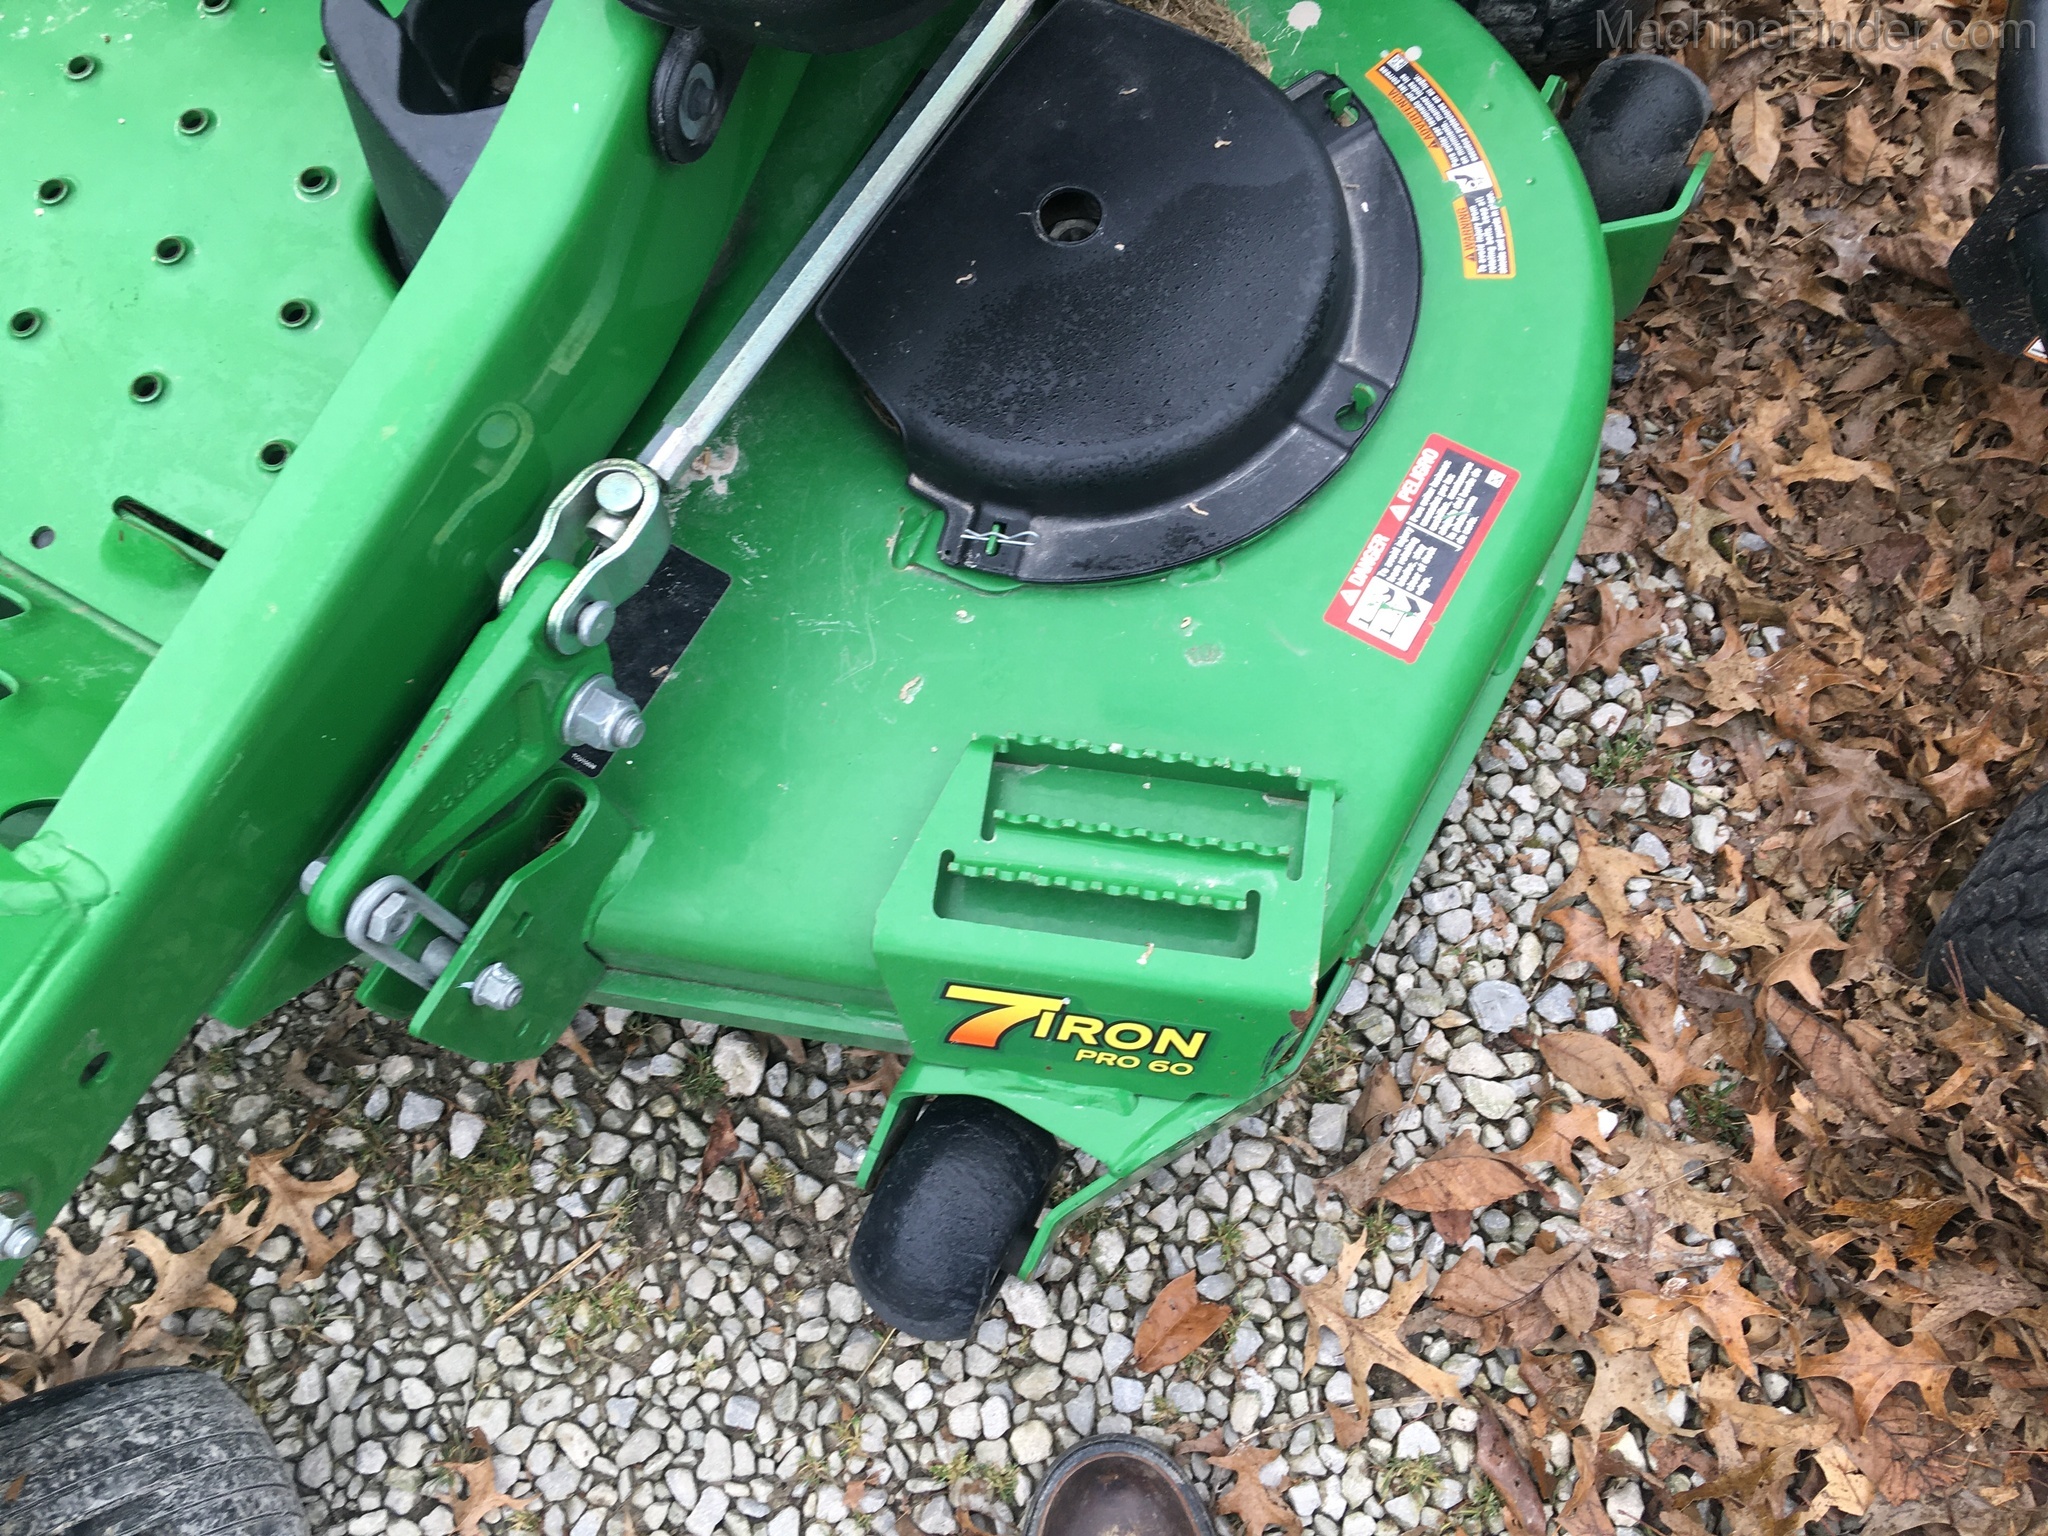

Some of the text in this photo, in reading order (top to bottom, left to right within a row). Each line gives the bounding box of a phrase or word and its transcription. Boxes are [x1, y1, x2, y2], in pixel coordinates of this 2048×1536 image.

[1457, 207, 1474, 250] WARNING
[1348, 533, 1390, 587] DANGER
[1397, 447, 1439, 503] PELIGRO
[1075, 1049, 1194, 1075] PRO 60
